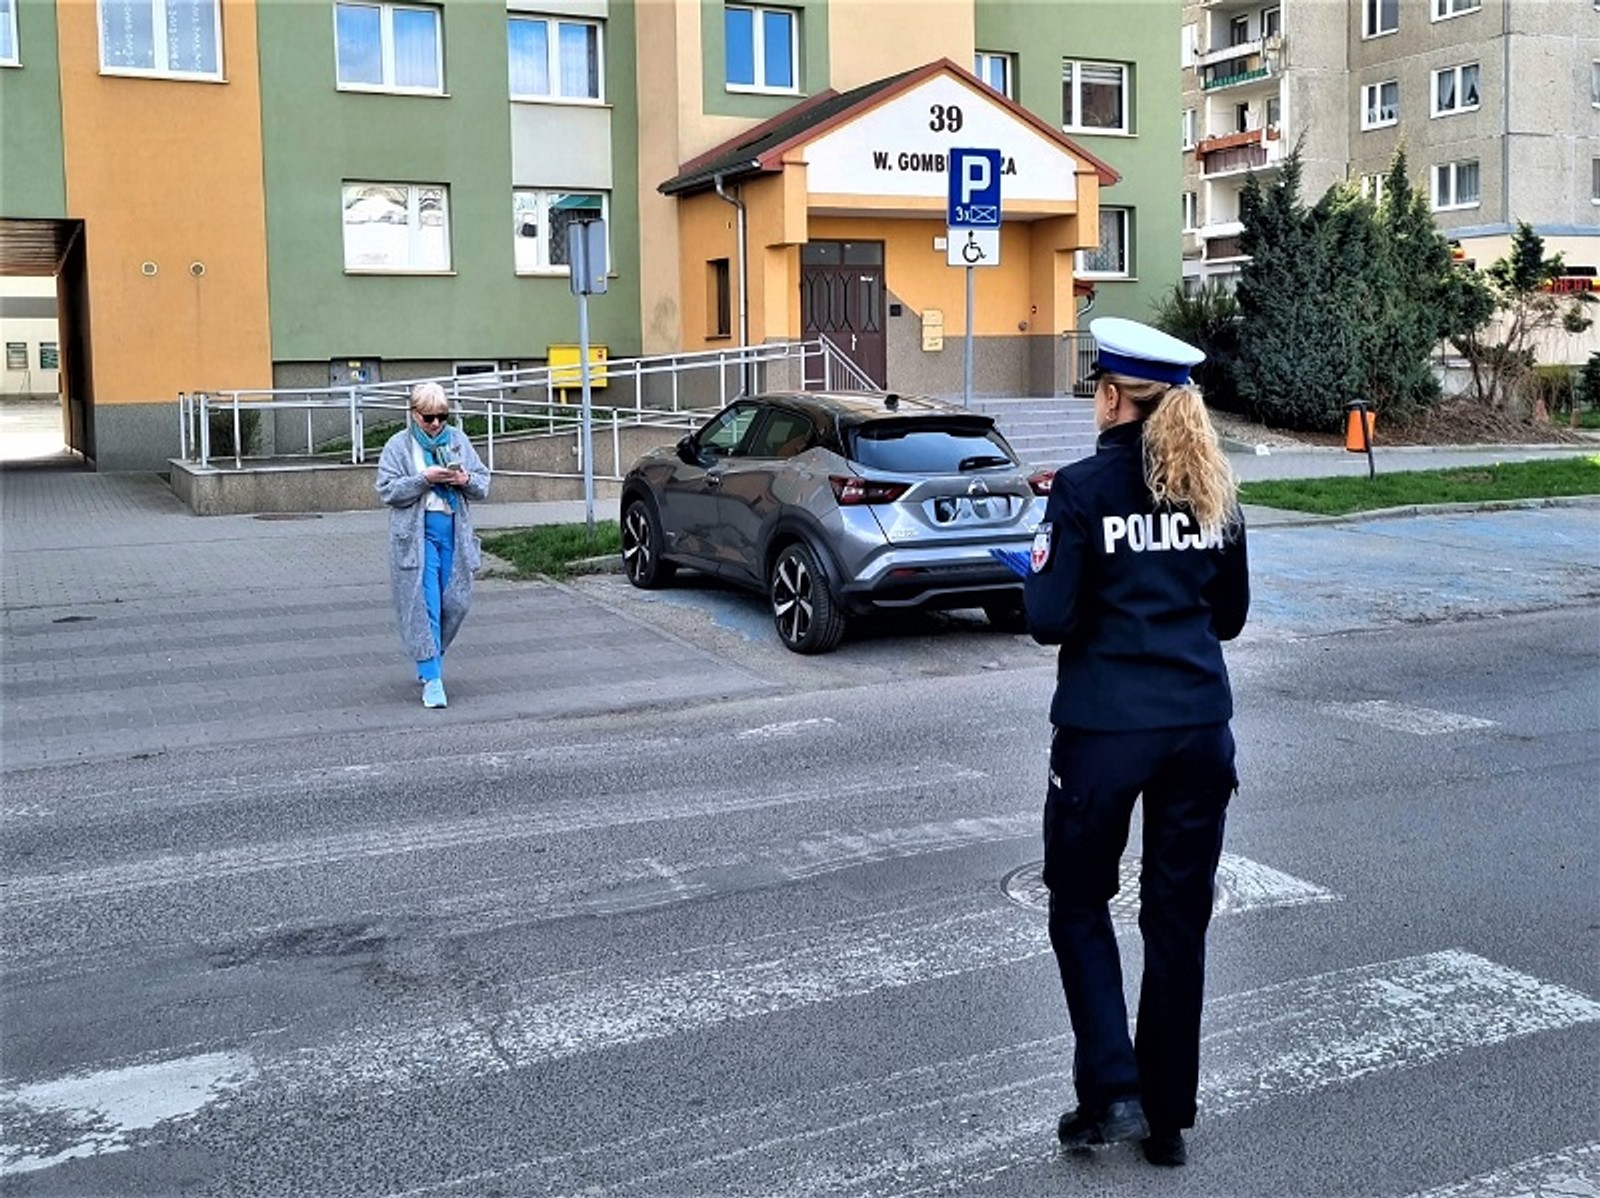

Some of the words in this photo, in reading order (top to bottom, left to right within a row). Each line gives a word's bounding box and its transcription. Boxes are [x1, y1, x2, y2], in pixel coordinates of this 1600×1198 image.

[929, 104, 963, 132] 39
[873, 151, 892, 170] W.
[962, 155, 991, 203] P
[955, 206, 970, 221] 3x
